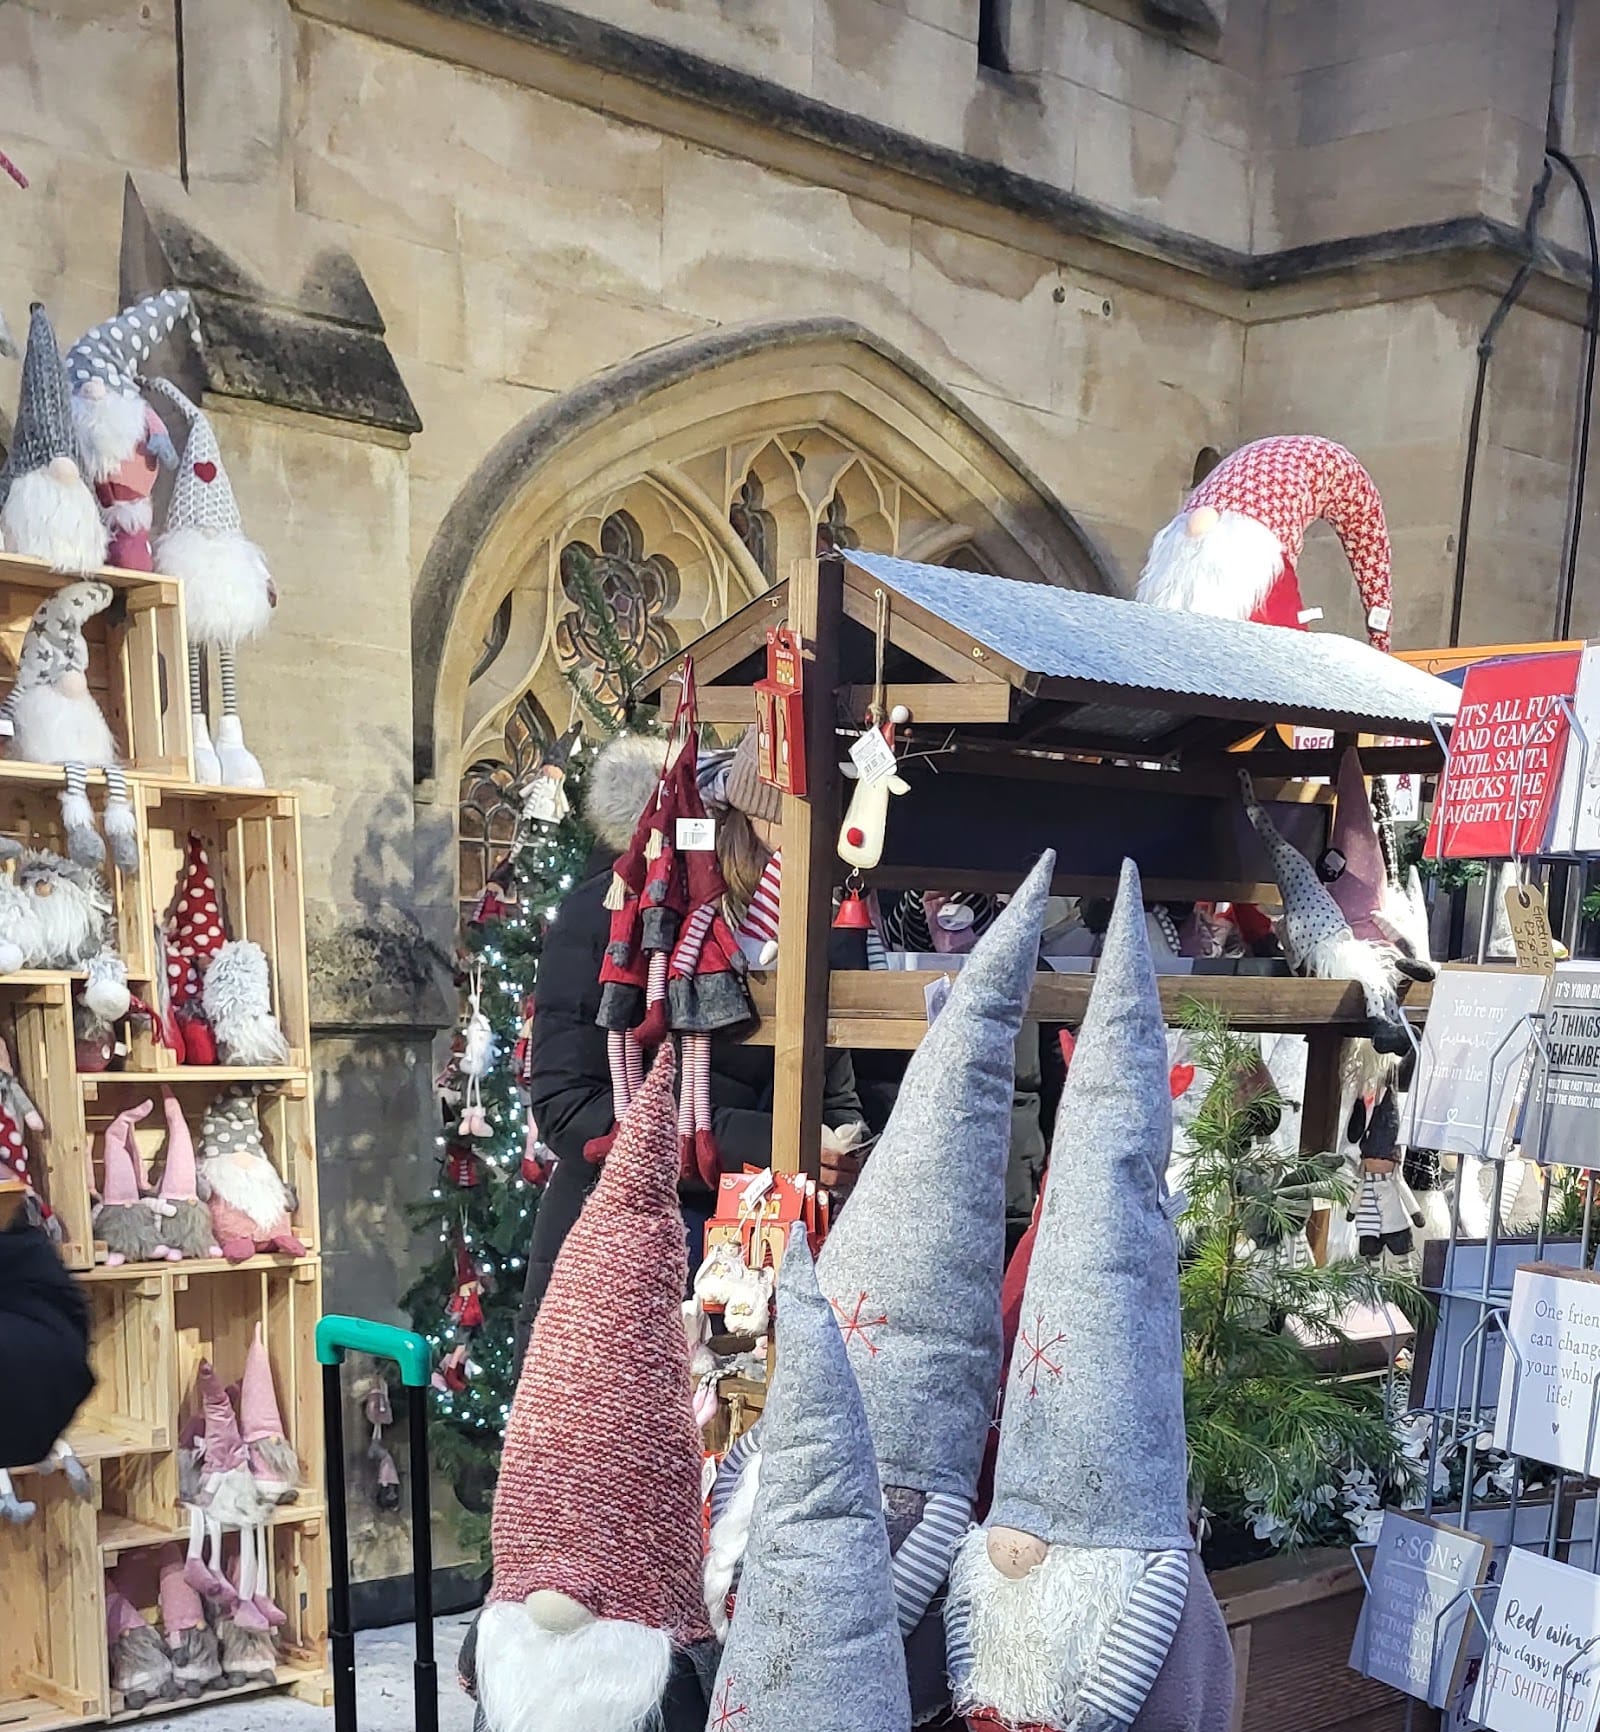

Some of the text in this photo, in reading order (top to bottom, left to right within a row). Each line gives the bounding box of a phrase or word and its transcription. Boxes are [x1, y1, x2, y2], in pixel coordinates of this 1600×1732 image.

[1458, 694, 1563, 728] IT'S ALL FUN
[1453, 720, 1558, 752] AND GAMES
[1449, 748, 1549, 776] UNTIL SANTA
[1441, 772, 1546, 801] CHECKS THE
[1434, 799, 1540, 825] NAUGHTY LST
[1555, 981, 1570, 998] IT'S
[1571, 983, 1591, 999] YOUR
[1454, 999, 1504, 1022] You're my
[1549, 1011, 1600, 1038] 2 THINGS
[1546, 1042, 1600, 1067] REMEMBE
[1451, 1063, 1462, 1080] in
[1465, 1065, 1484, 1081] the
[1535, 1300, 1600, 1329] One frien
[1530, 1333, 1553, 1347] can
[1525, 1359, 1594, 1384] your whol
[1546, 1384, 1573, 1408] life!
[1407, 1536, 1449, 1570] SON
[1504, 1599, 1543, 1639] Red
[1515, 1645, 1550, 1678] classy
[1553, 1663, 1592, 1687] pople
